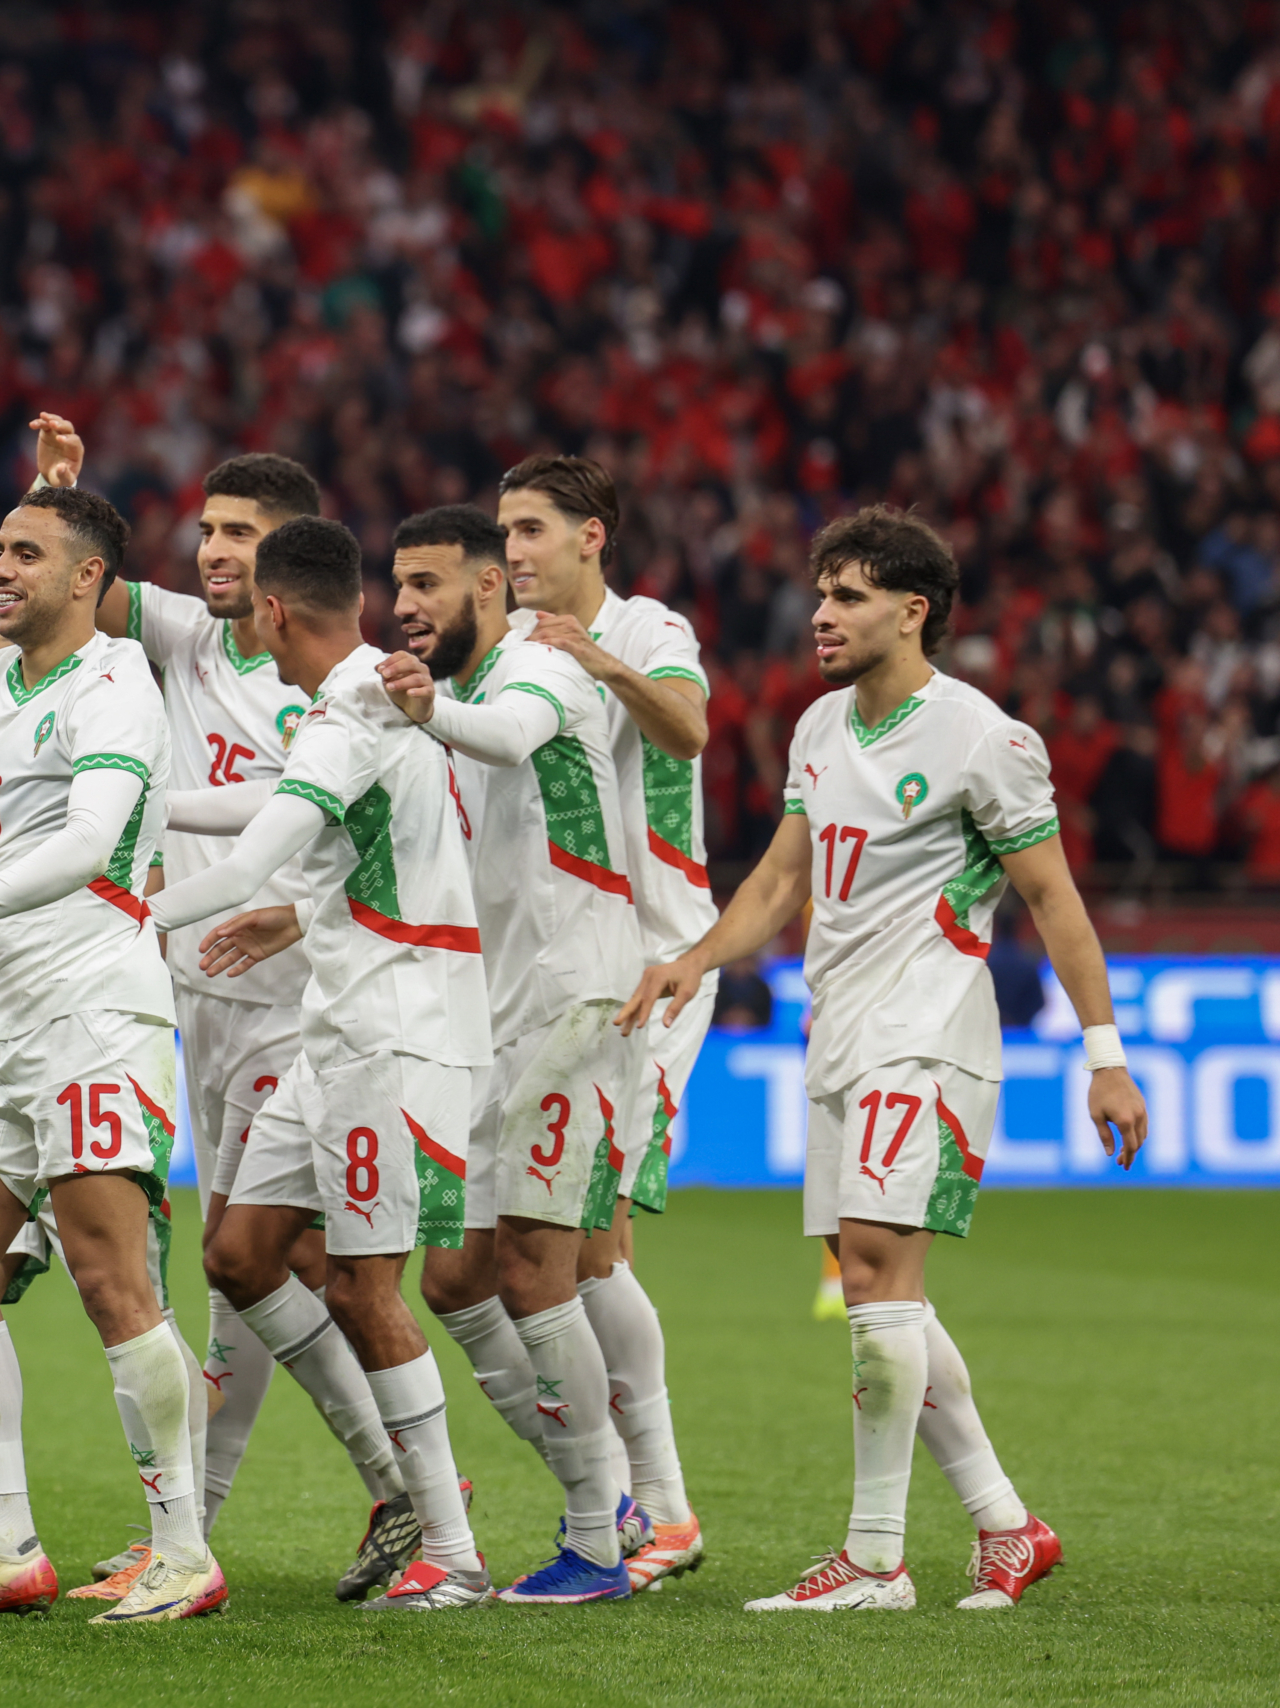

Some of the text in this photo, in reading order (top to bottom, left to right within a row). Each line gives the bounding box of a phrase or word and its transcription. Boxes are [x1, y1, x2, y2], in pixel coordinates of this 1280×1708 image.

[207, 733, 255, 786] 25
[820, 823, 868, 901] 17
[58, 1083, 121, 1158] 15
[530, 1093, 571, 1166] 3
[728, 1043, 1280, 1175] TCNO
[859, 1090, 922, 1168] 17
[346, 1127, 379, 1201] 8
